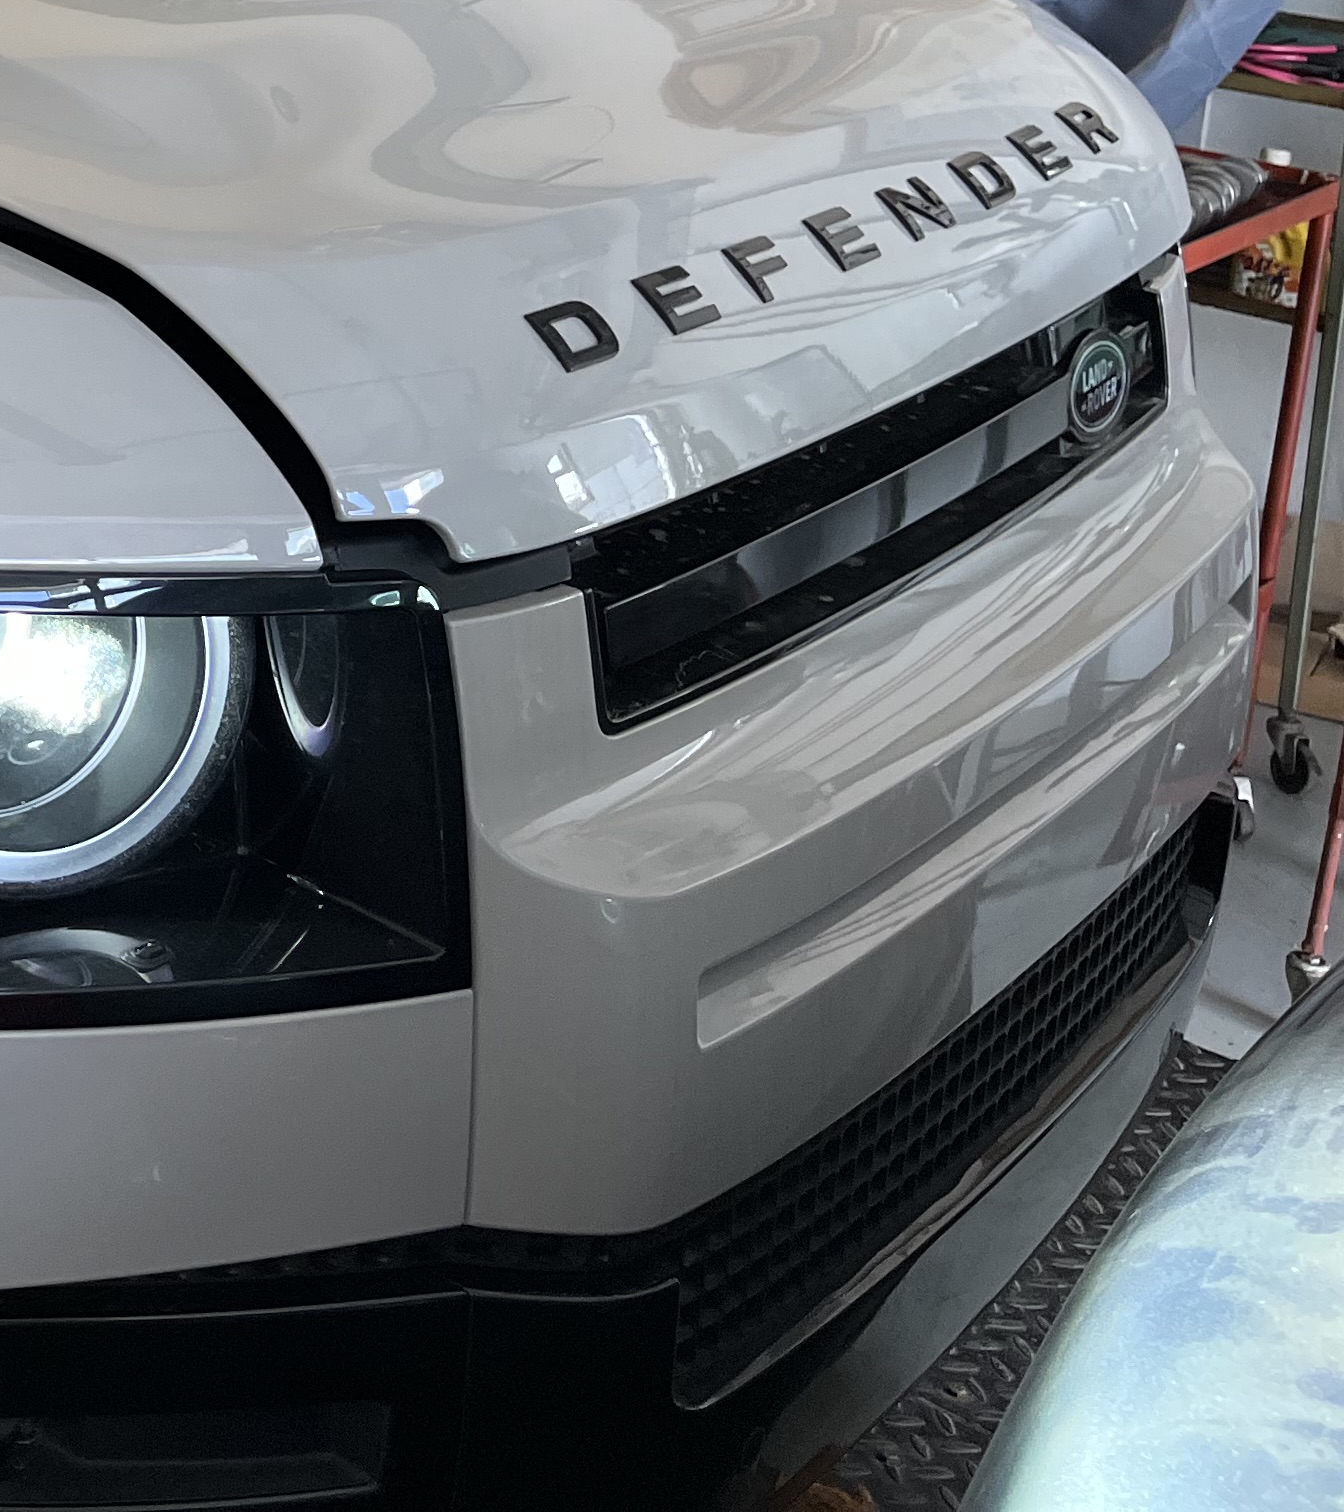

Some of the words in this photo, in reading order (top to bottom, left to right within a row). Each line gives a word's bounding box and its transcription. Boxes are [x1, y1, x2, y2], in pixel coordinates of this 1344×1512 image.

[522, 100, 1120, 373] DEFENDER
[1082, 358, 1108, 393] LAND
[1087, 376, 1117, 416] ROVER
